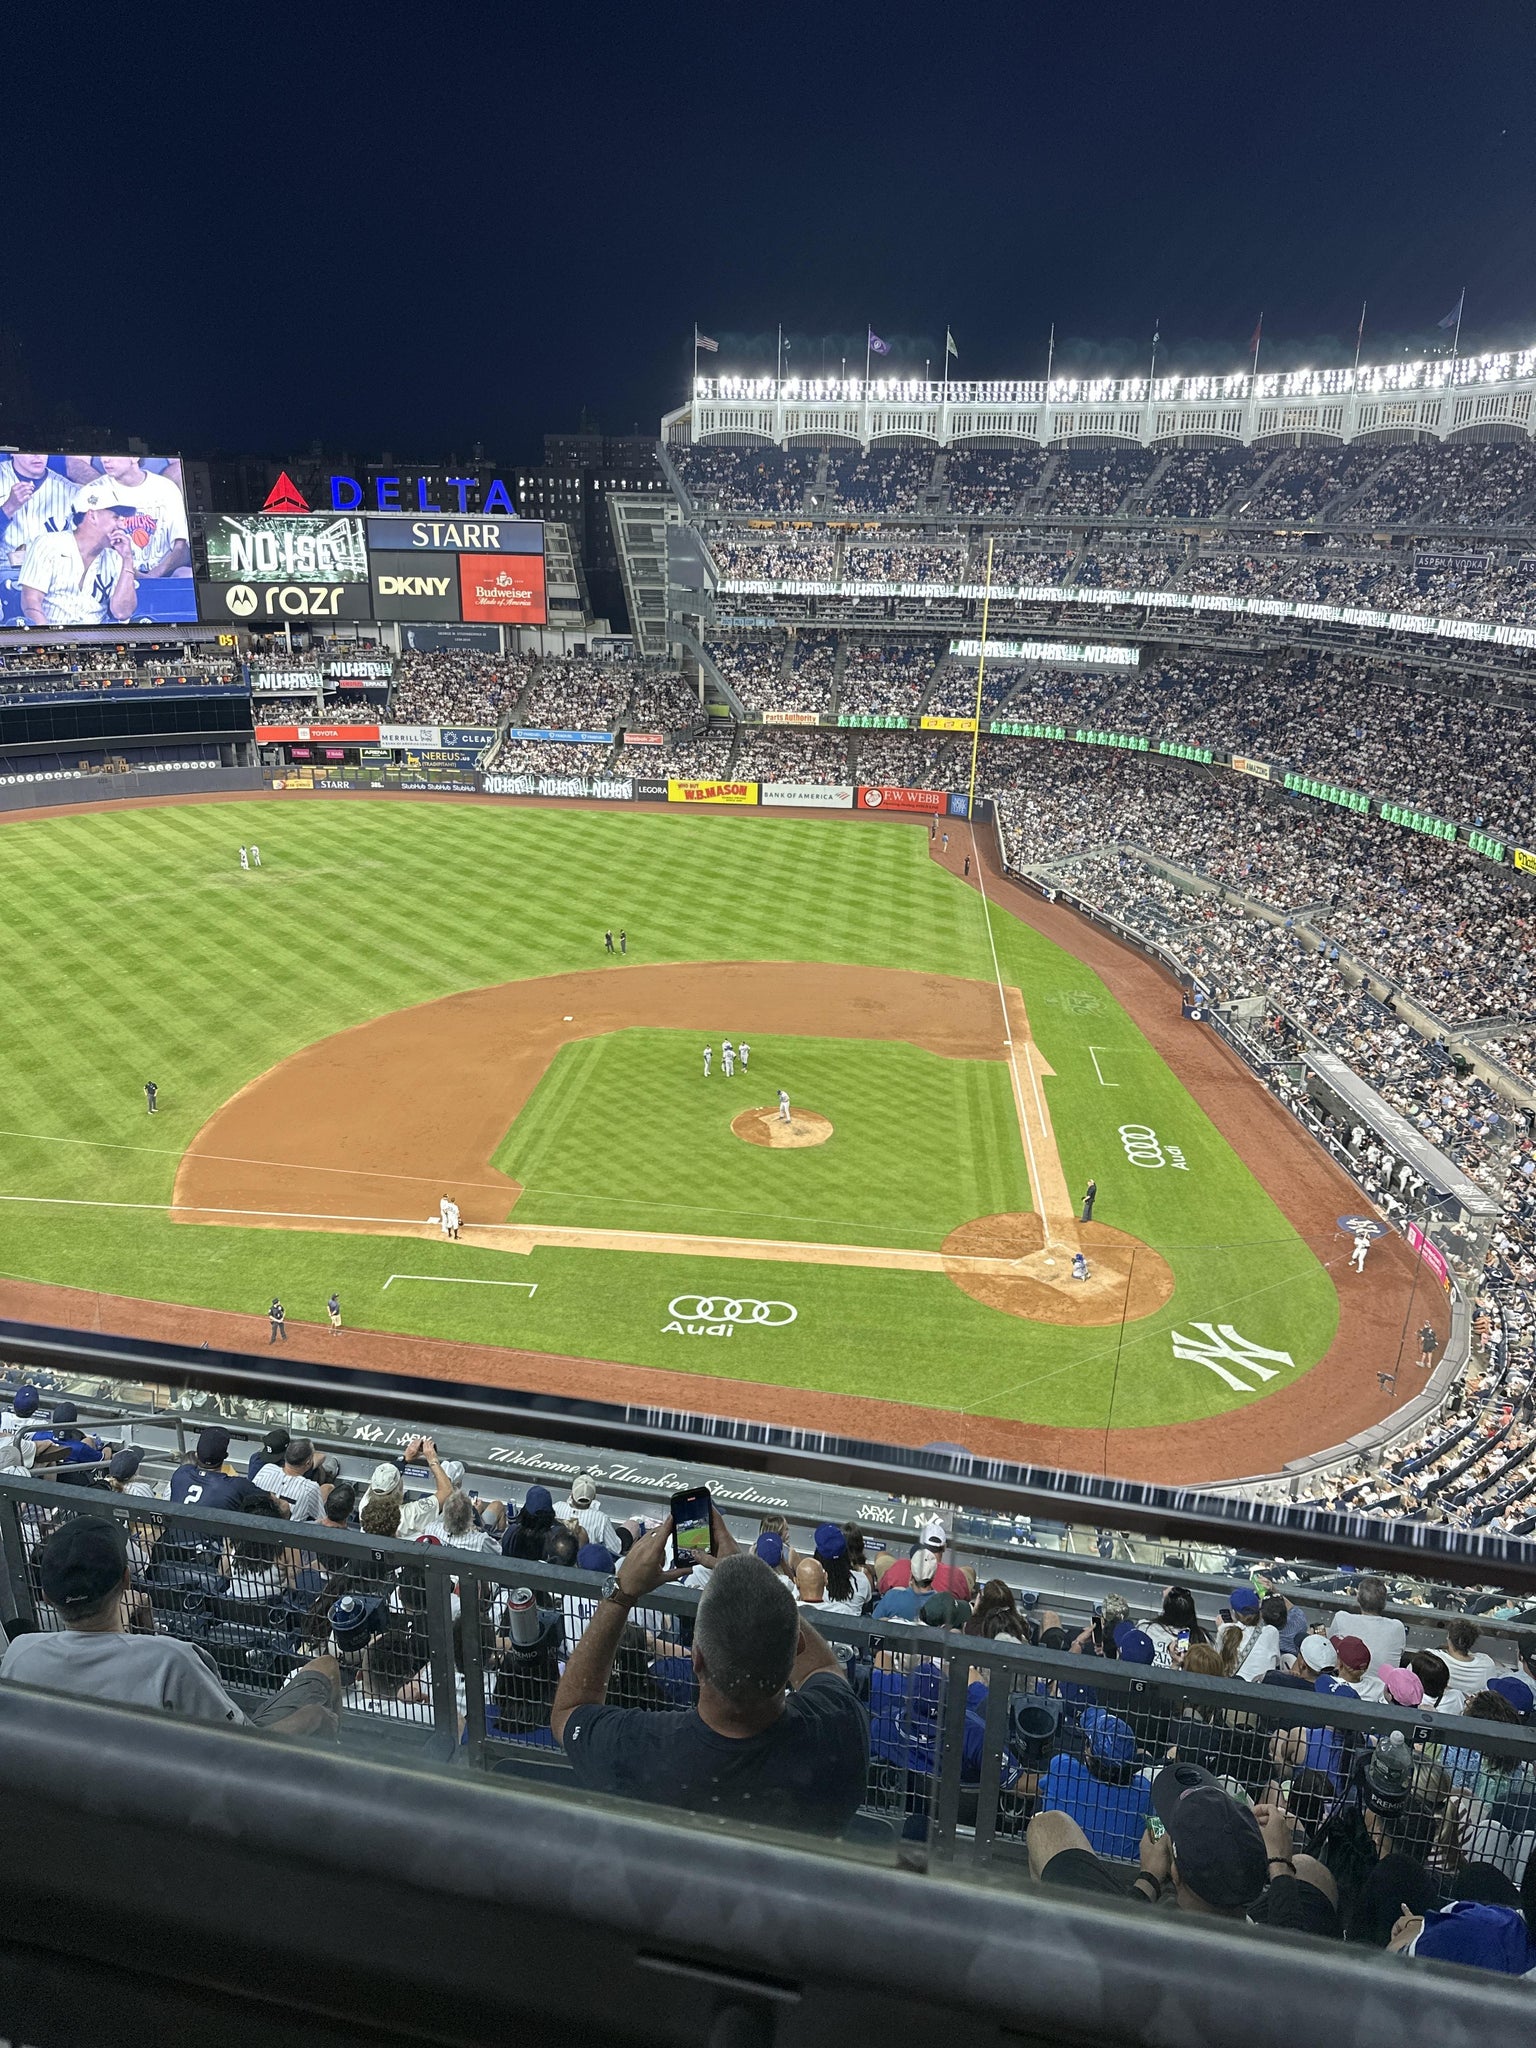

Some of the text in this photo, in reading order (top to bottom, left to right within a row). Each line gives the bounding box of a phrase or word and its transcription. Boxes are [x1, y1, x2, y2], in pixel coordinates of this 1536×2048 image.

[330, 476, 515, 514] DELTA
[412, 522, 500, 548] STARR
[378, 575, 451, 596] DKNY
[475, 586, 533, 598] Budweiser
[265, 586, 344, 615] razr
[784, 714, 817, 723] Authority
[462, 735, 492, 743] CLEAR
[421, 751, 460, 761] NEREUS
[401, 782, 426, 790] StubHub
[428, 783, 452, 791] StubHub
[638, 786, 668, 794] LEGORA
[883, 790, 940, 804] F.W. WEBB
[1163, 1145, 1190, 1171] Audi
[660, 1320, 734, 1337] Audi
[488, 1447, 581, 1474] Welcome
[585, 1464, 608, 1478] to
[608, 1463, 691, 1491] Yankee
[183, 1484, 203, 1505] 2
[861, 1504, 895, 1516] NEW
[151, 1514, 163, 1524] 10
[856, 1510, 896, 1525] YORK
[375, 1551, 382, 1561] 9
[873, 1636, 882, 1646] 7
[1135, 1681, 1144, 1691] 6
[1419, 1728, 1428, 1740] 5
